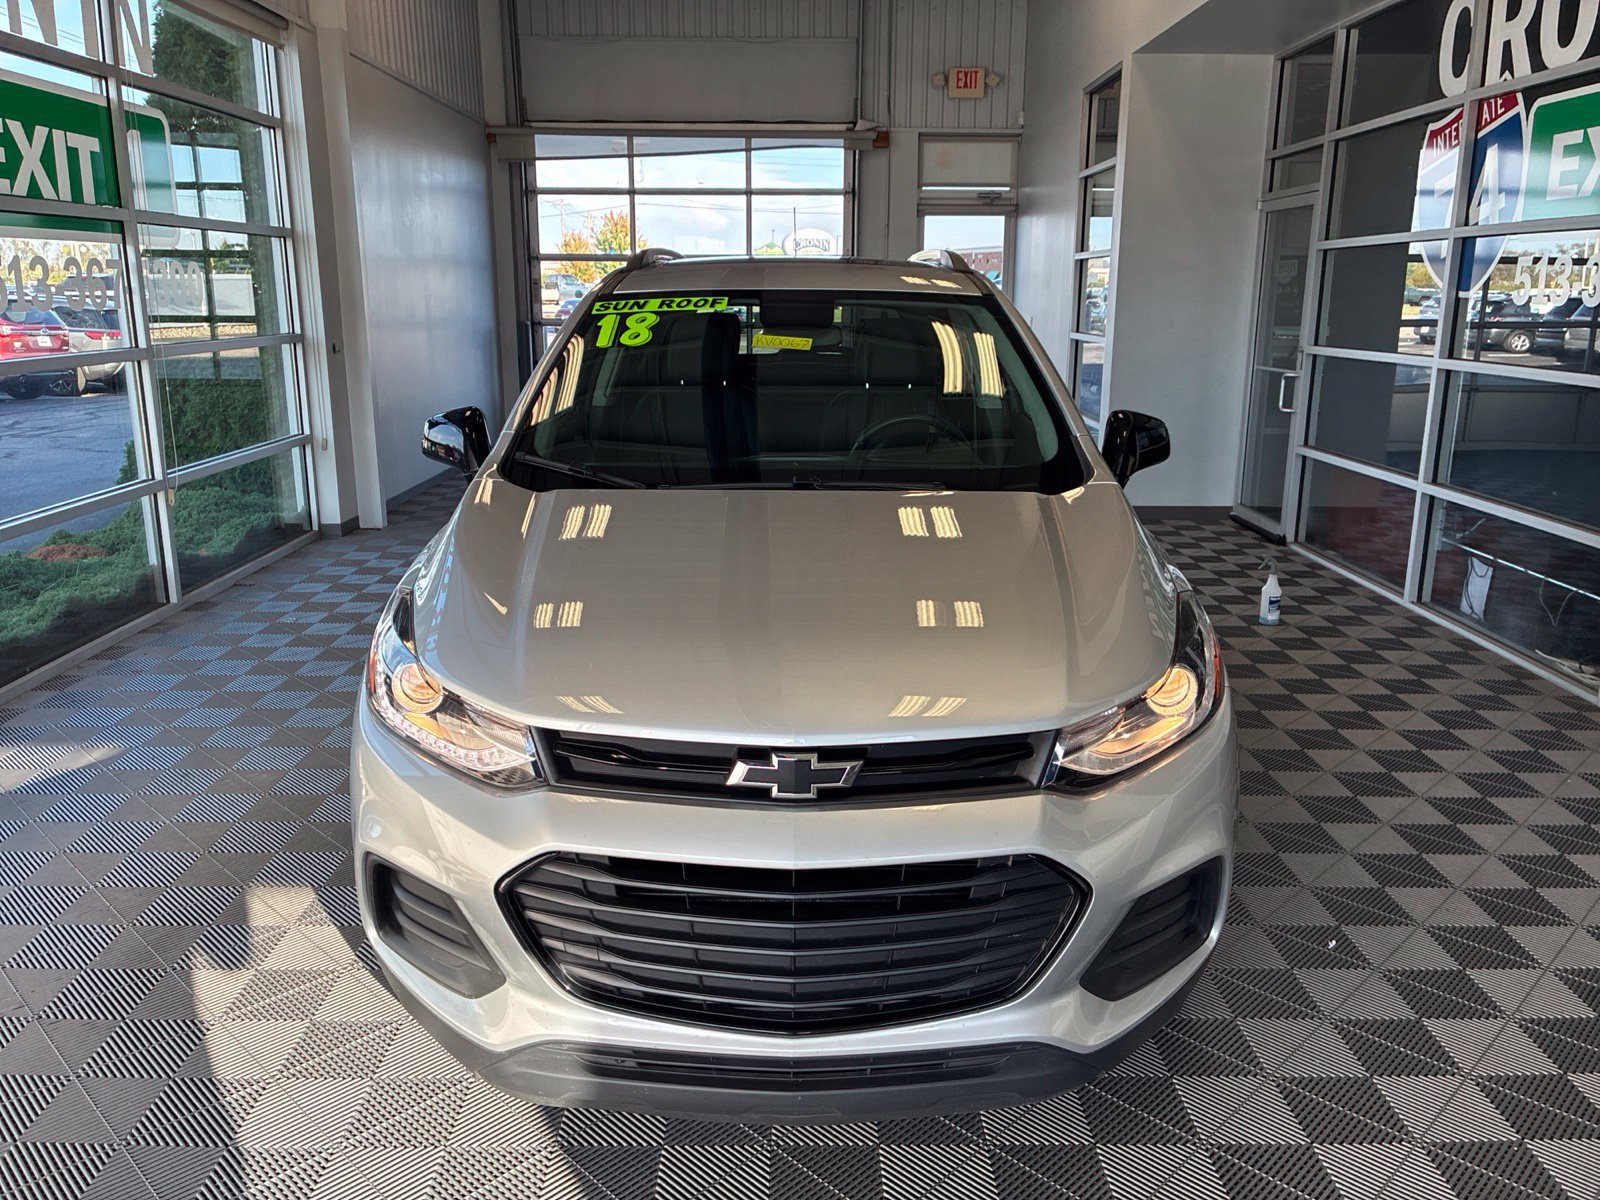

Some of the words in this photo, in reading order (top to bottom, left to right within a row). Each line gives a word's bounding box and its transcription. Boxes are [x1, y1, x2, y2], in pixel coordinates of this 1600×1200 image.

[1439, 0, 1599, 98] CRO
[956, 70, 979, 89] EXIT
[1433, 98, 1506, 158] INTEATE
[0, 117, 100, 205] XIT
[595, 299, 648, 312] SUN
[657, 297, 725, 310] ROOF
[595, 312, 661, 348] 18
